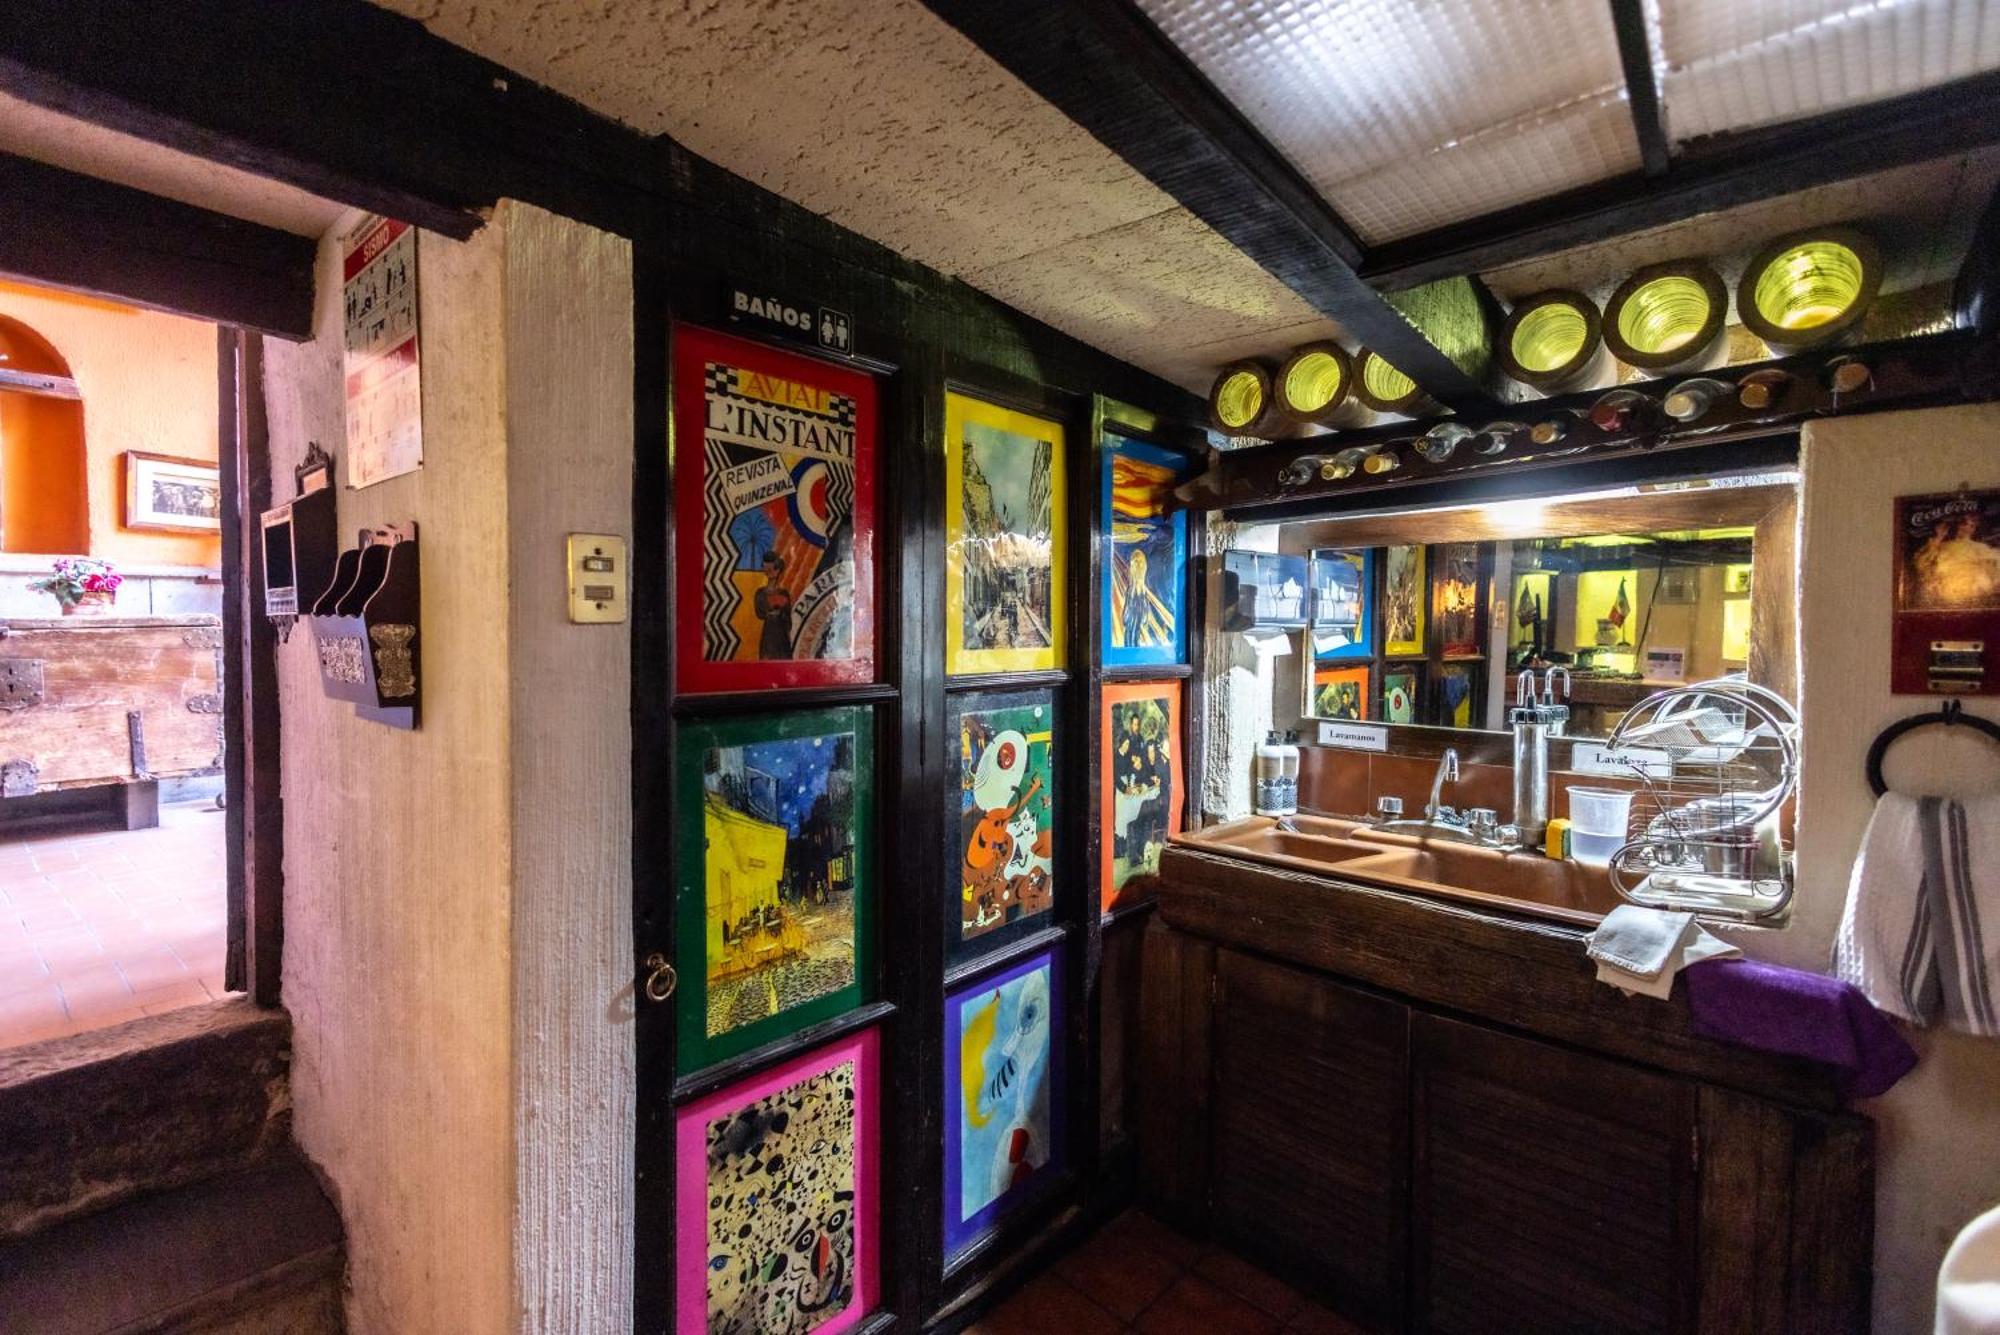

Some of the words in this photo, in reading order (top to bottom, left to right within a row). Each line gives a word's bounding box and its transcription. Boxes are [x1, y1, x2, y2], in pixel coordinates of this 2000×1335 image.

[363, 224, 391, 263] SISMO
[734, 290, 812, 331] BAÑOS
[703, 399, 856, 458] L'INSTANT
[726, 457, 782, 488] REVISTA
[734, 477, 794, 512] QUINZENAL
[1329, 729, 1376, 742] Lavamanos
